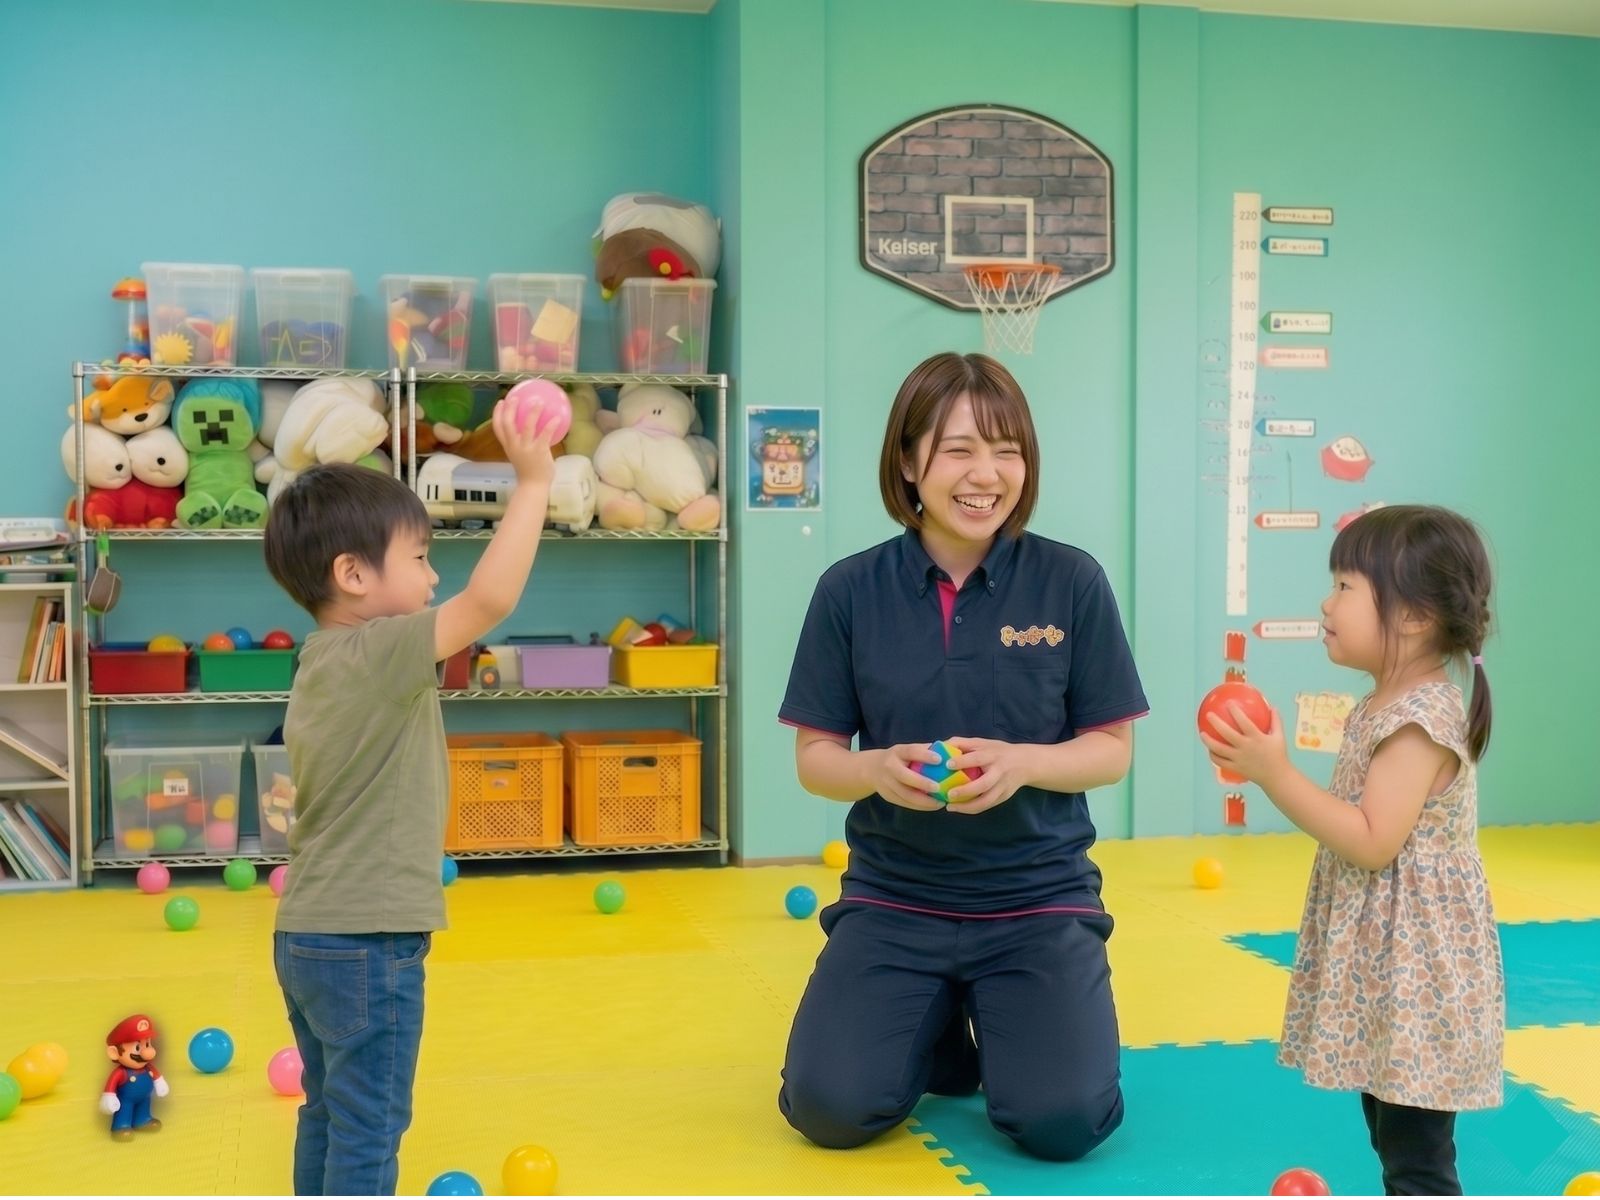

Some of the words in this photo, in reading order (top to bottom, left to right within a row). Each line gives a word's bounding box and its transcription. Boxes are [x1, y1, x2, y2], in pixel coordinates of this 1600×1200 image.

[1239, 210, 1258, 221] 220
[879, 237, 938, 256] Keiser
[1239, 240, 1258, 250] 210
[1238, 361, 1255, 371] 120
